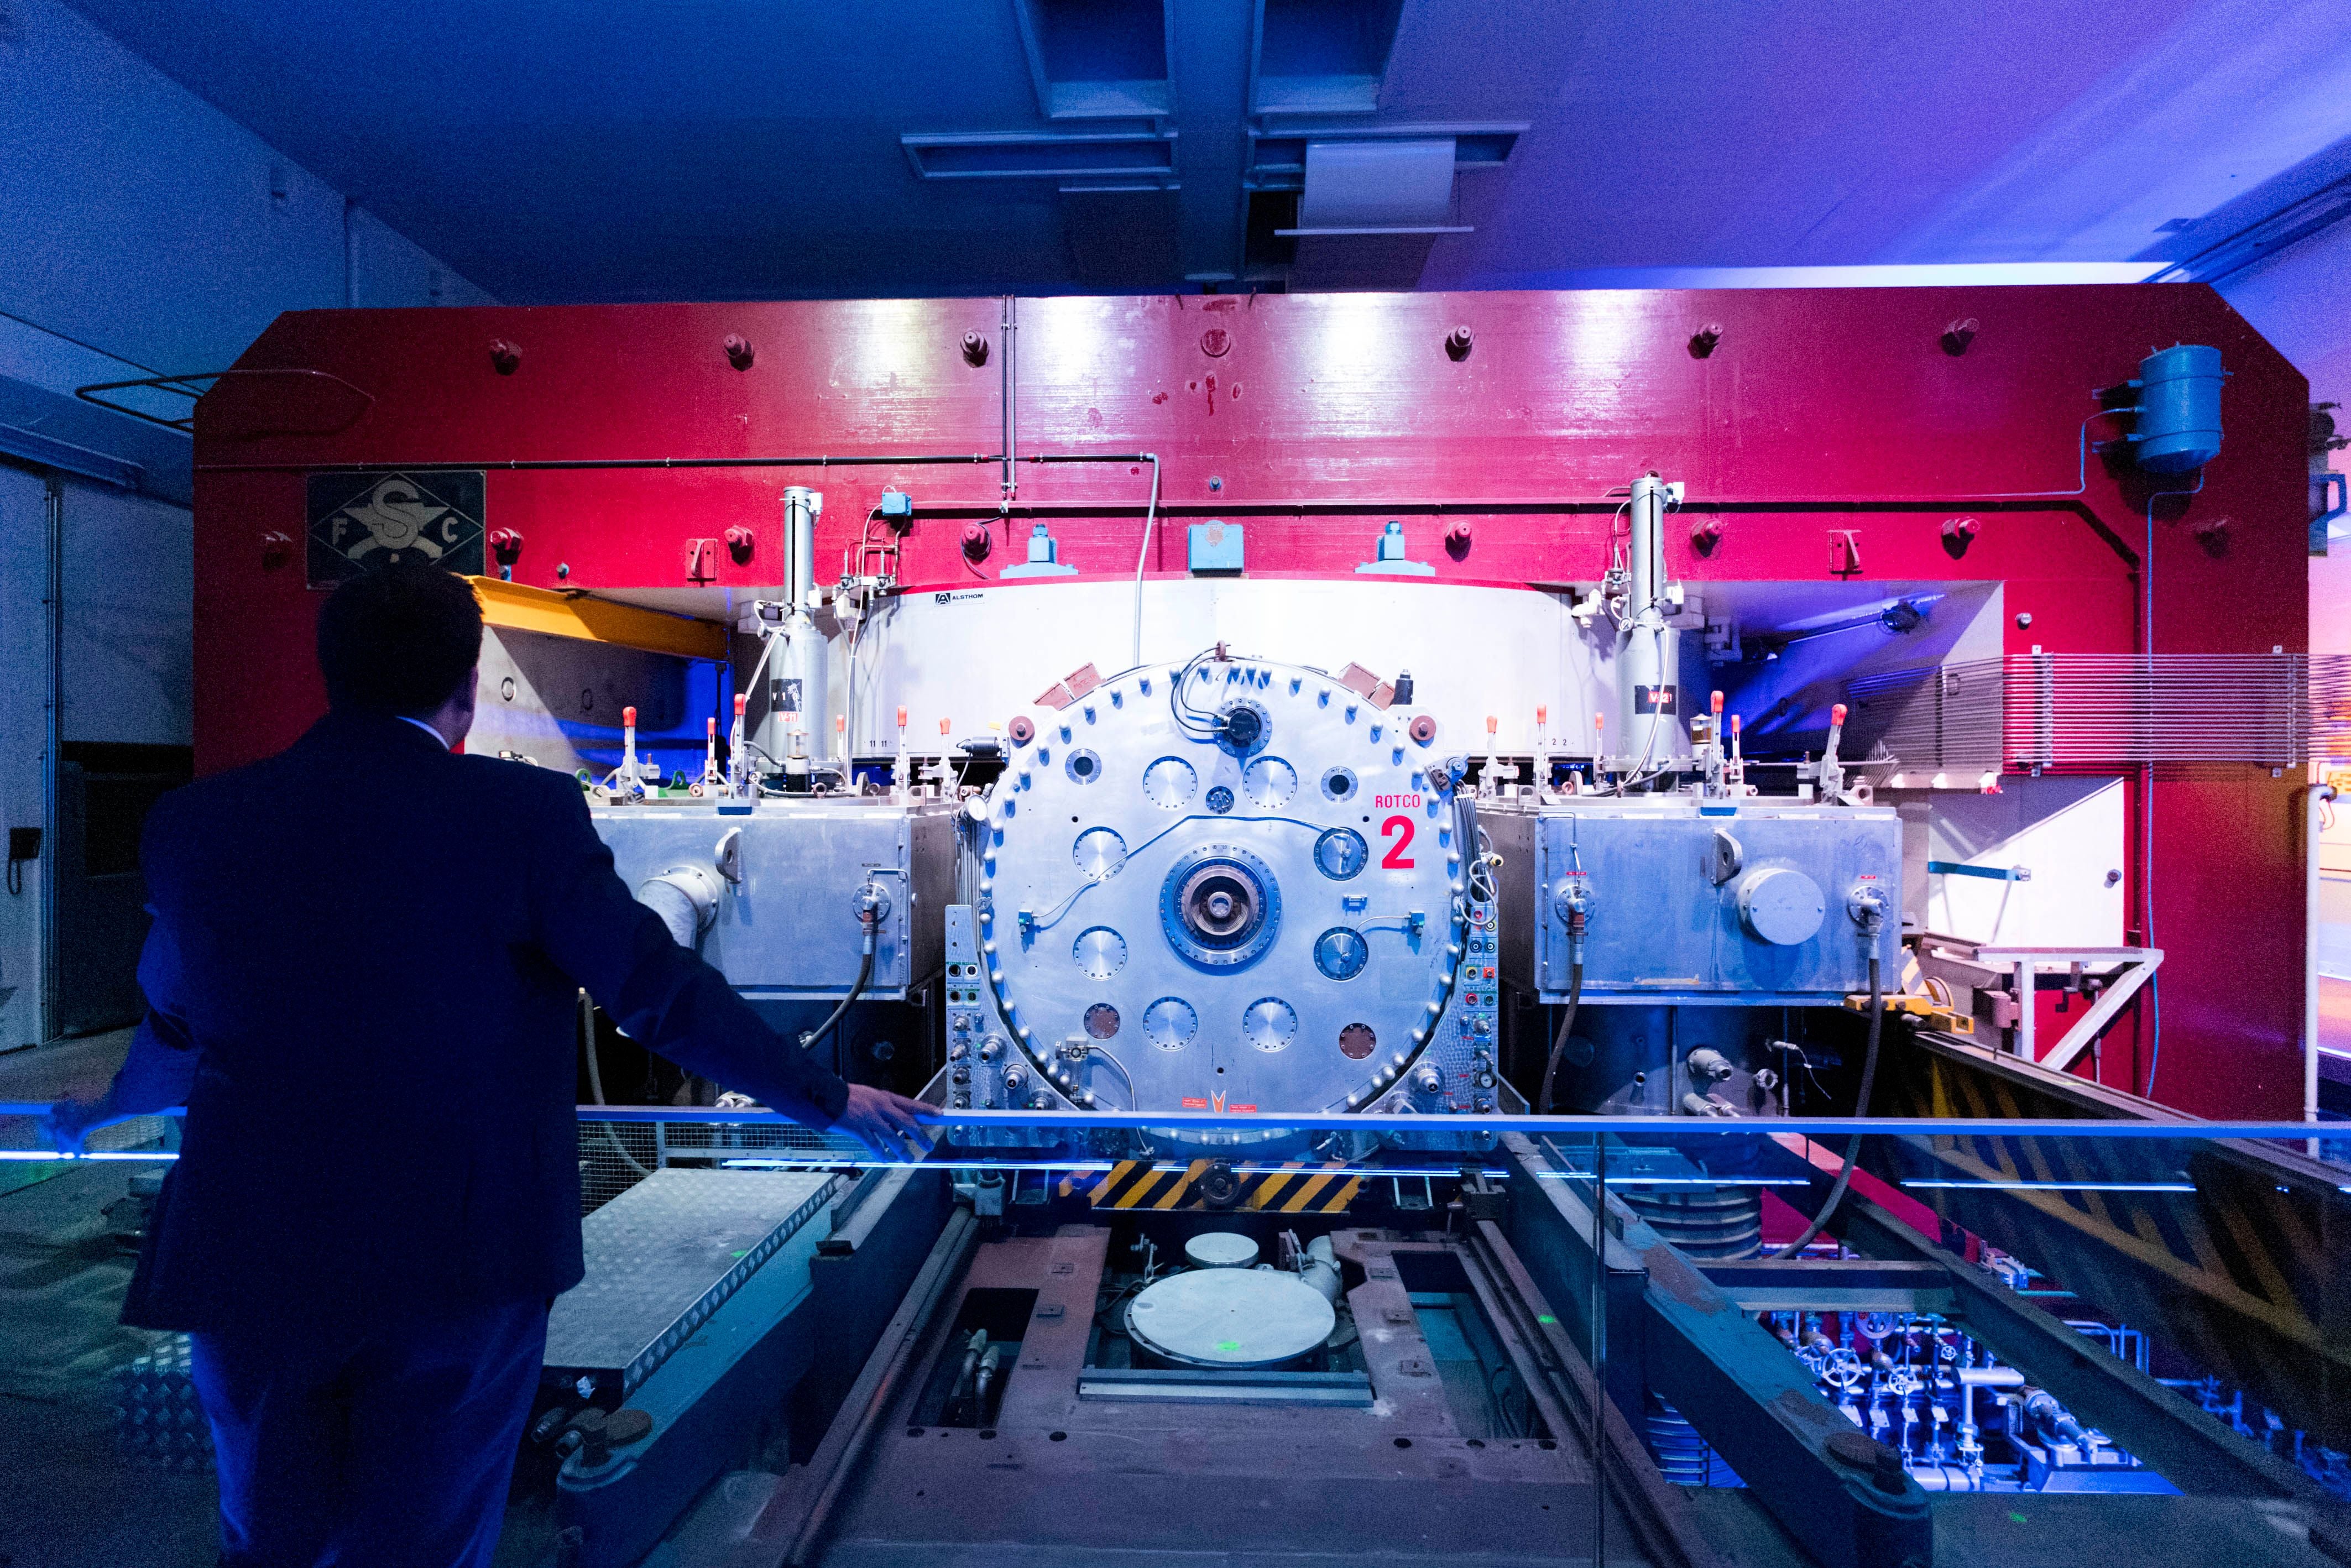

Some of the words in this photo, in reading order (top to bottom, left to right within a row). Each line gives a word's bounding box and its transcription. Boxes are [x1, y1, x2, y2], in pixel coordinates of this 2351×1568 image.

[332, 517, 348, 545] F
[372, 480, 420, 549] S
[442, 516, 458, 543] C
[780, 713, 797, 722] V-11
[1375, 795, 1420, 808] ROTCO
[1381, 815, 1414, 869] 2
